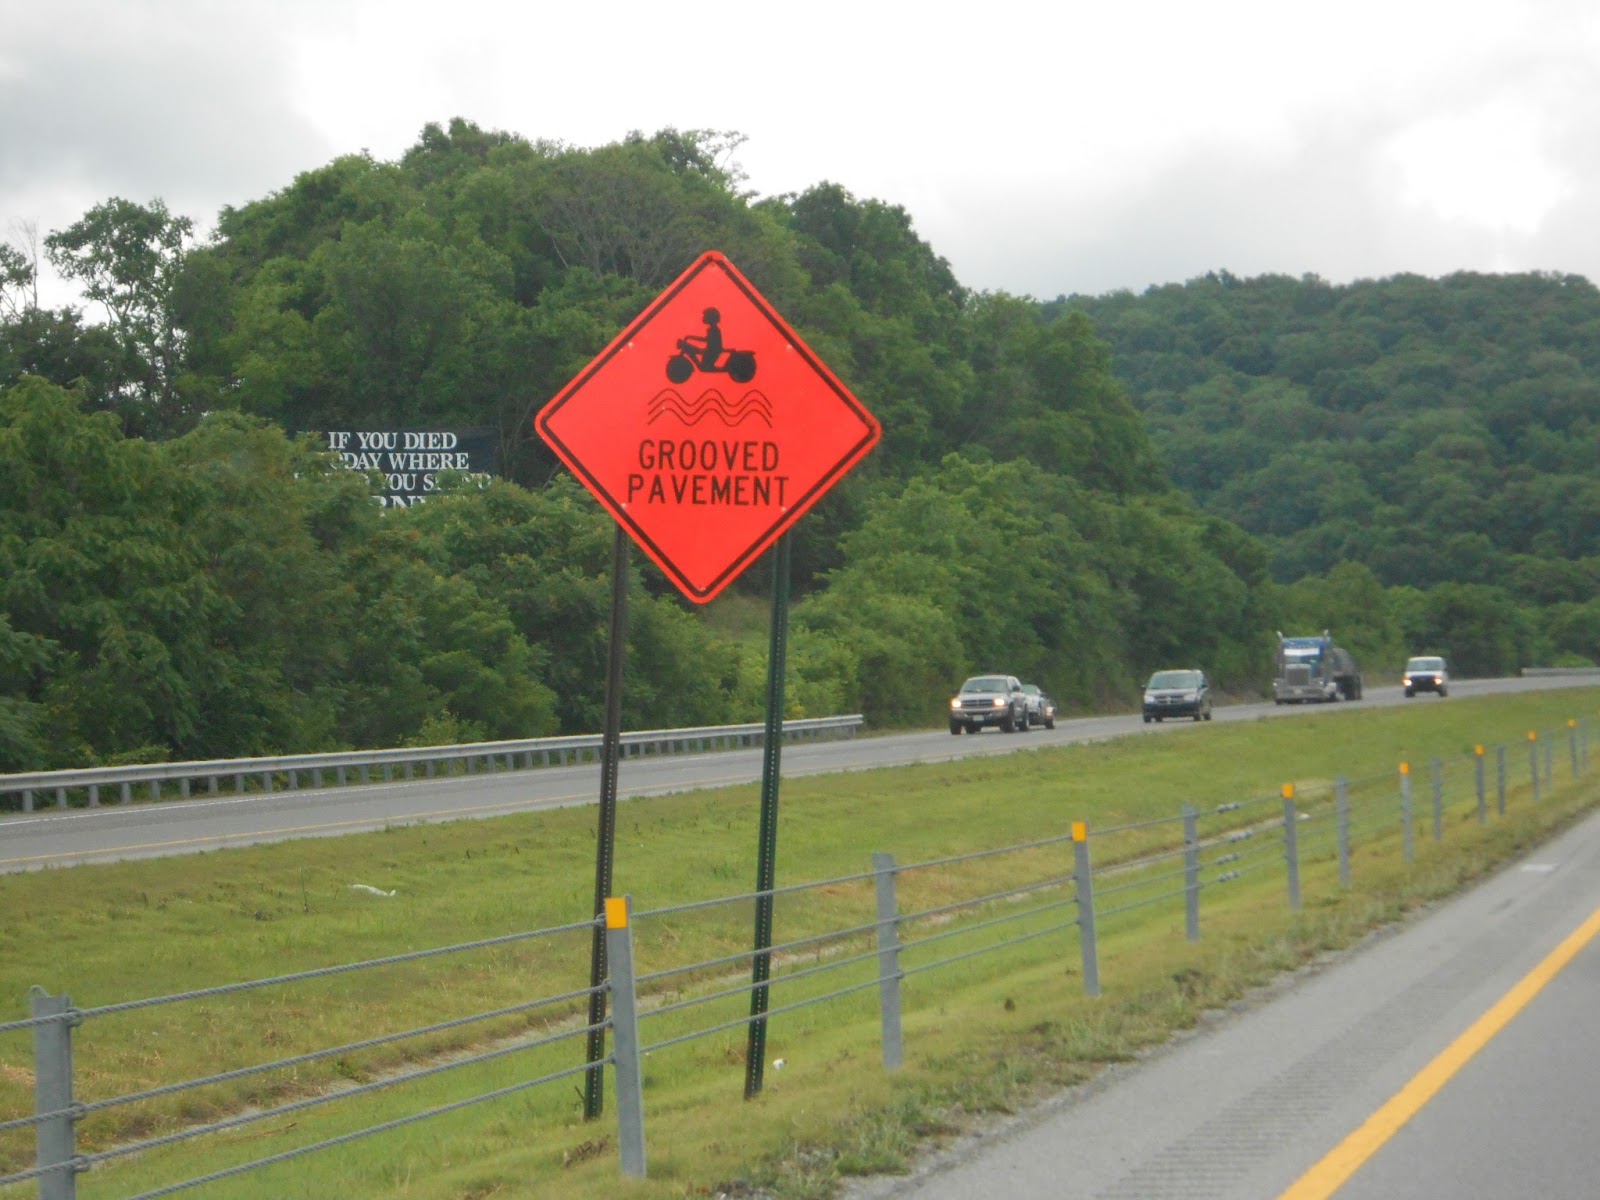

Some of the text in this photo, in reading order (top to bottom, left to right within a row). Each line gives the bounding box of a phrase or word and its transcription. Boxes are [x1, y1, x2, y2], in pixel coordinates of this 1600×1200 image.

[328, 431, 457, 450] IF YOU DIED
[388, 452, 469, 471] WHERE
[638, 439, 780, 472] GROOVED
[627, 473, 789, 506] PAVEMENT
